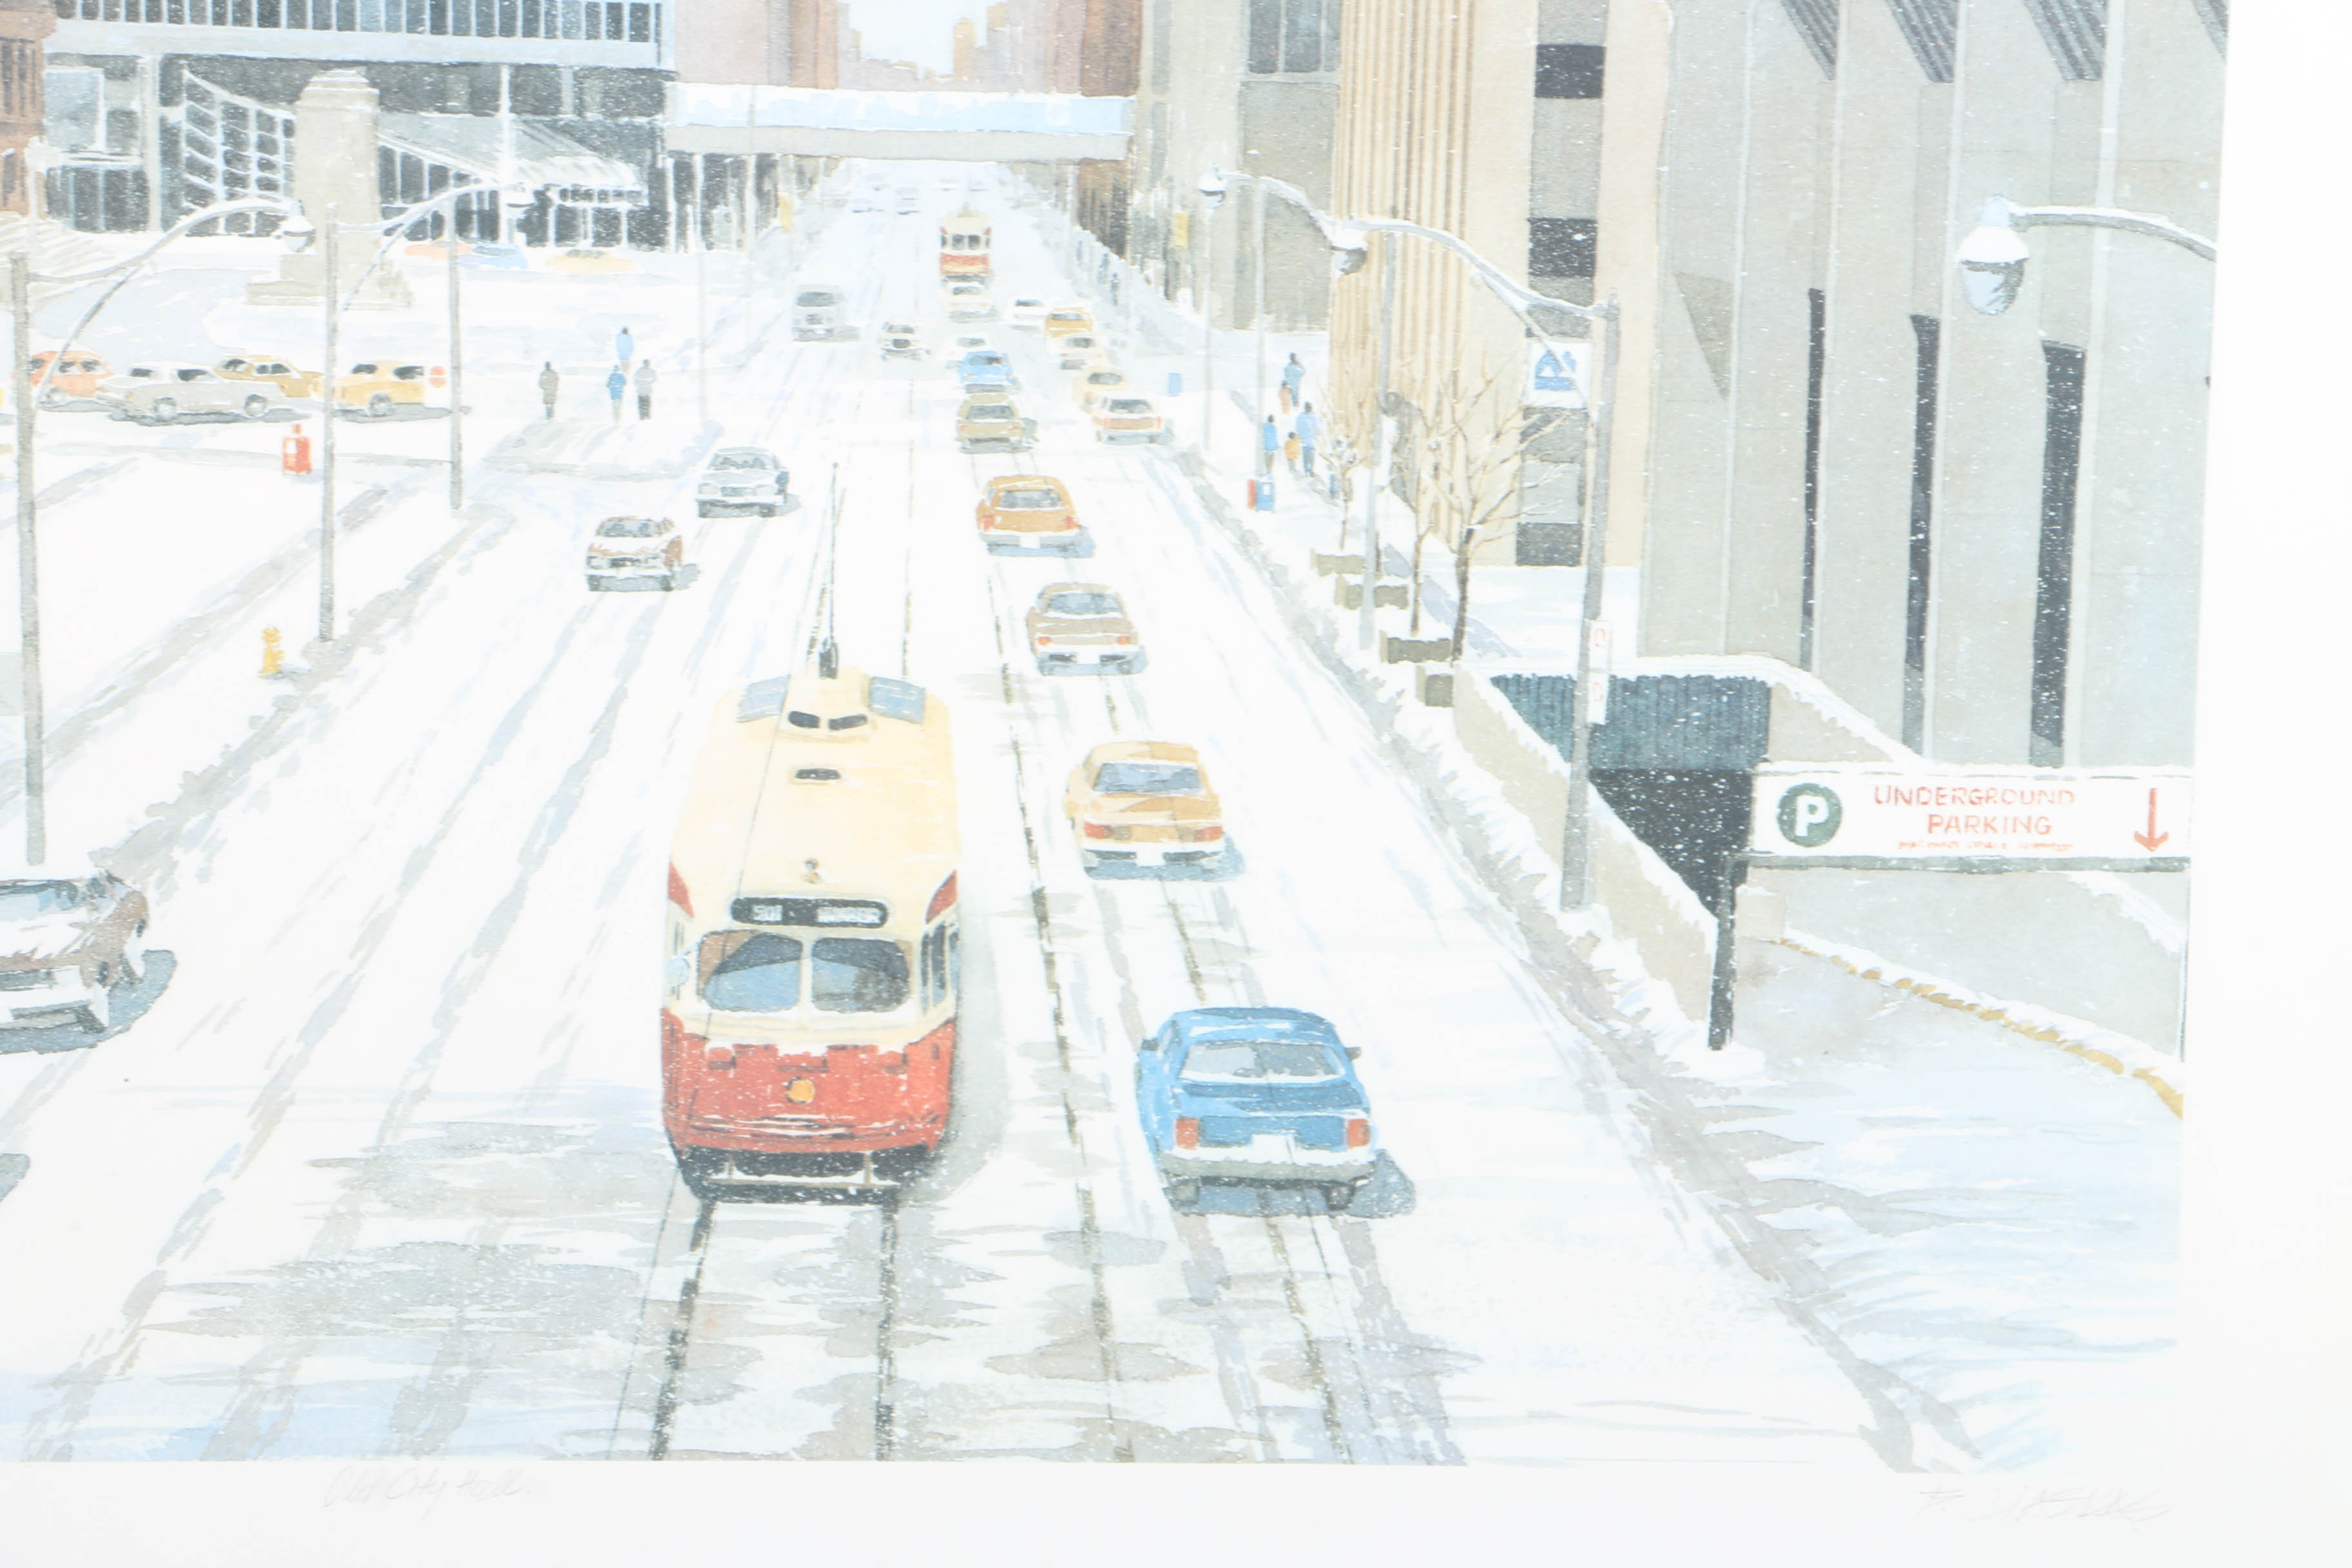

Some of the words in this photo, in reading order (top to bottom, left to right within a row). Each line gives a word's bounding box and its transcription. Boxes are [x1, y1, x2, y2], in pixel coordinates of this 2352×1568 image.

[1874, 785, 2075, 807] UNDERGROUND
[1795, 795, 1828, 837] P
[1927, 814, 2053, 835] PARKING
